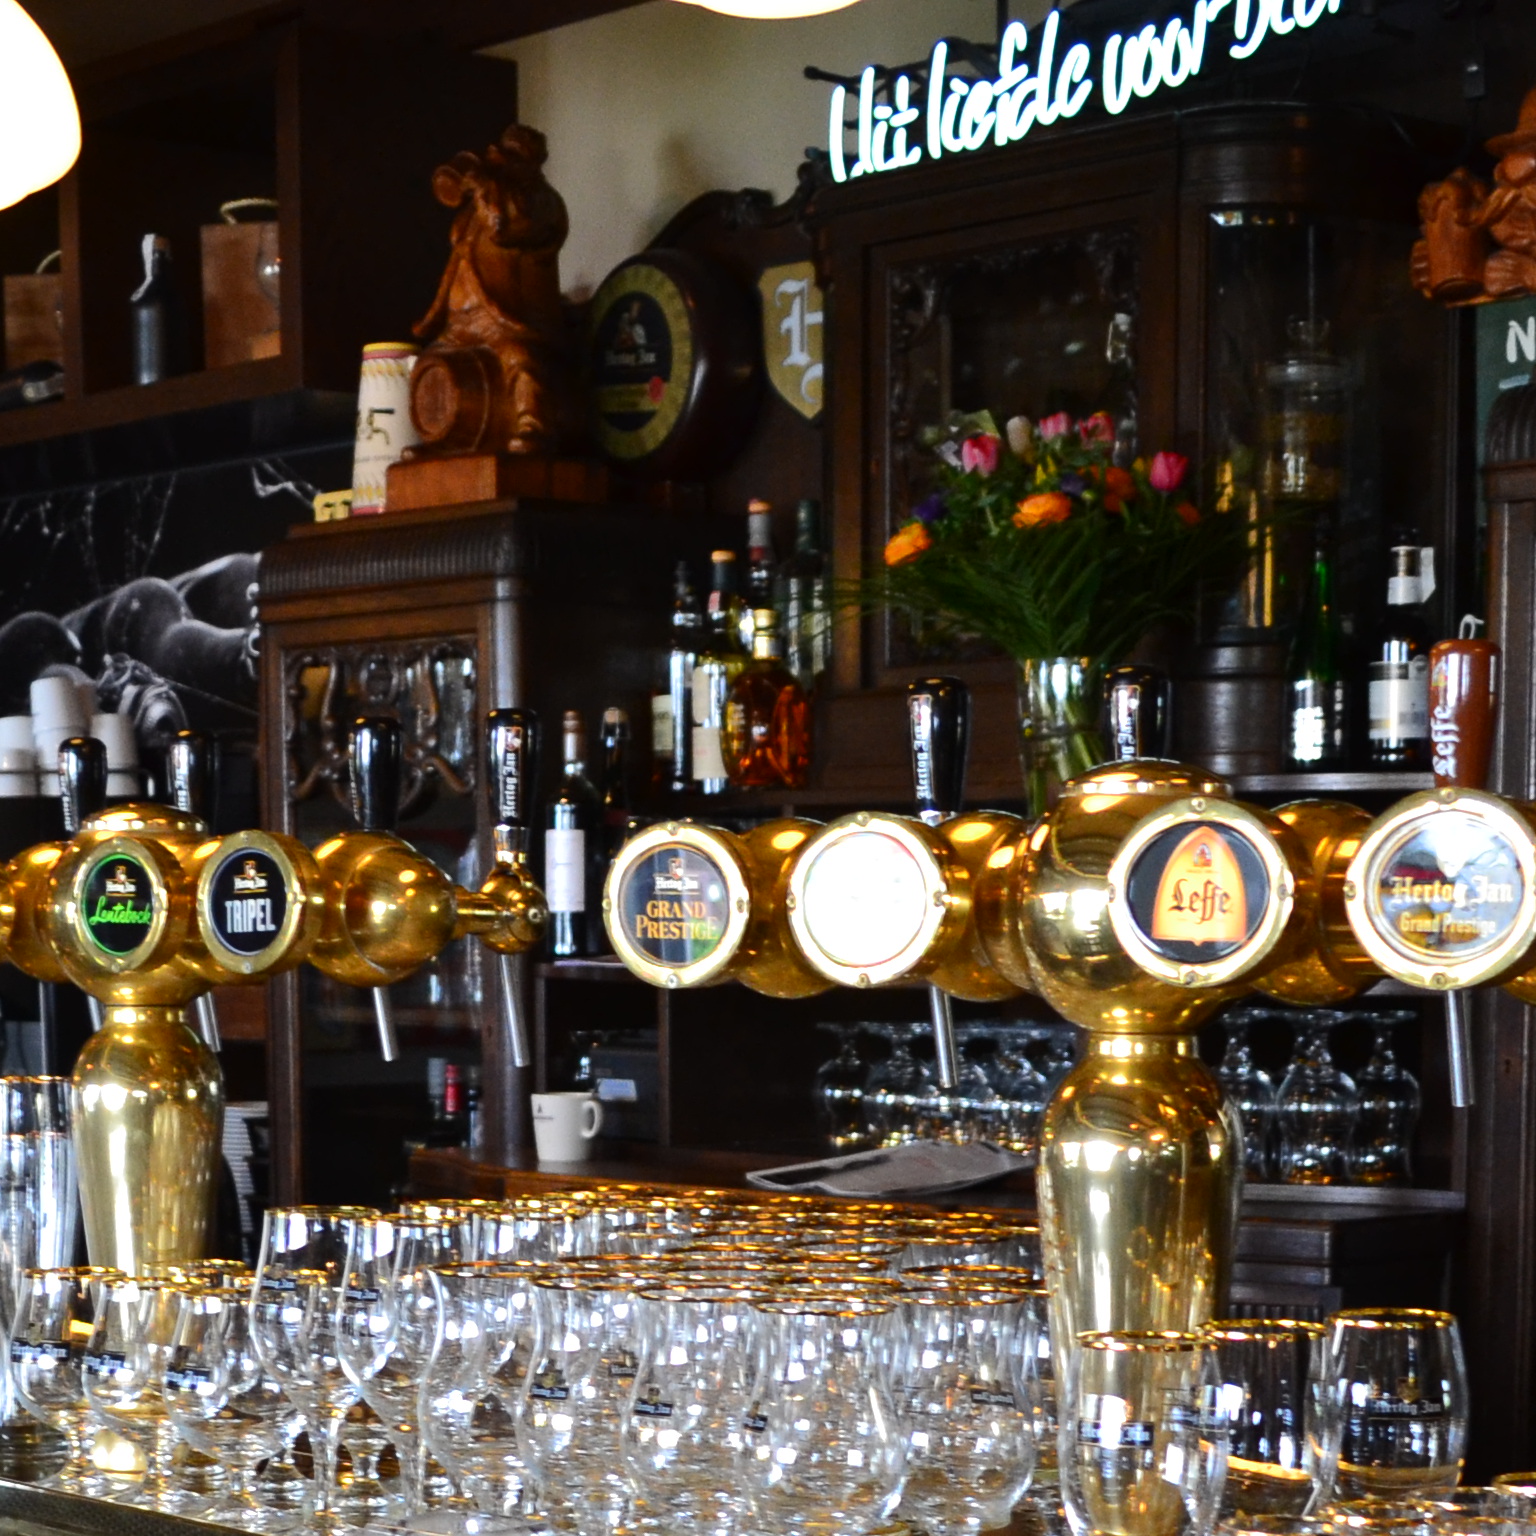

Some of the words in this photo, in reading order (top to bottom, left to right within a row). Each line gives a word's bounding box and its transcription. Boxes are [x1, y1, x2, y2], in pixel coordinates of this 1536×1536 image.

[830, 66, 921, 182] Uit
[927, 10, 1093, 161] liefde
[1102, 0, 1232, 115] voor
[1431, 704, 1460, 779] Leffe
[646, 900, 706, 918] GRAND
[1168, 878, 1233, 925] Leffe
[1389, 876, 1468, 911] Hertog
[1469, 875, 1514, 905] Jan
[225, 898, 277, 933] TRIPEL
[1399, 911, 1440, 933] Grand
[1443, 912, 1497, 938] Prestige
